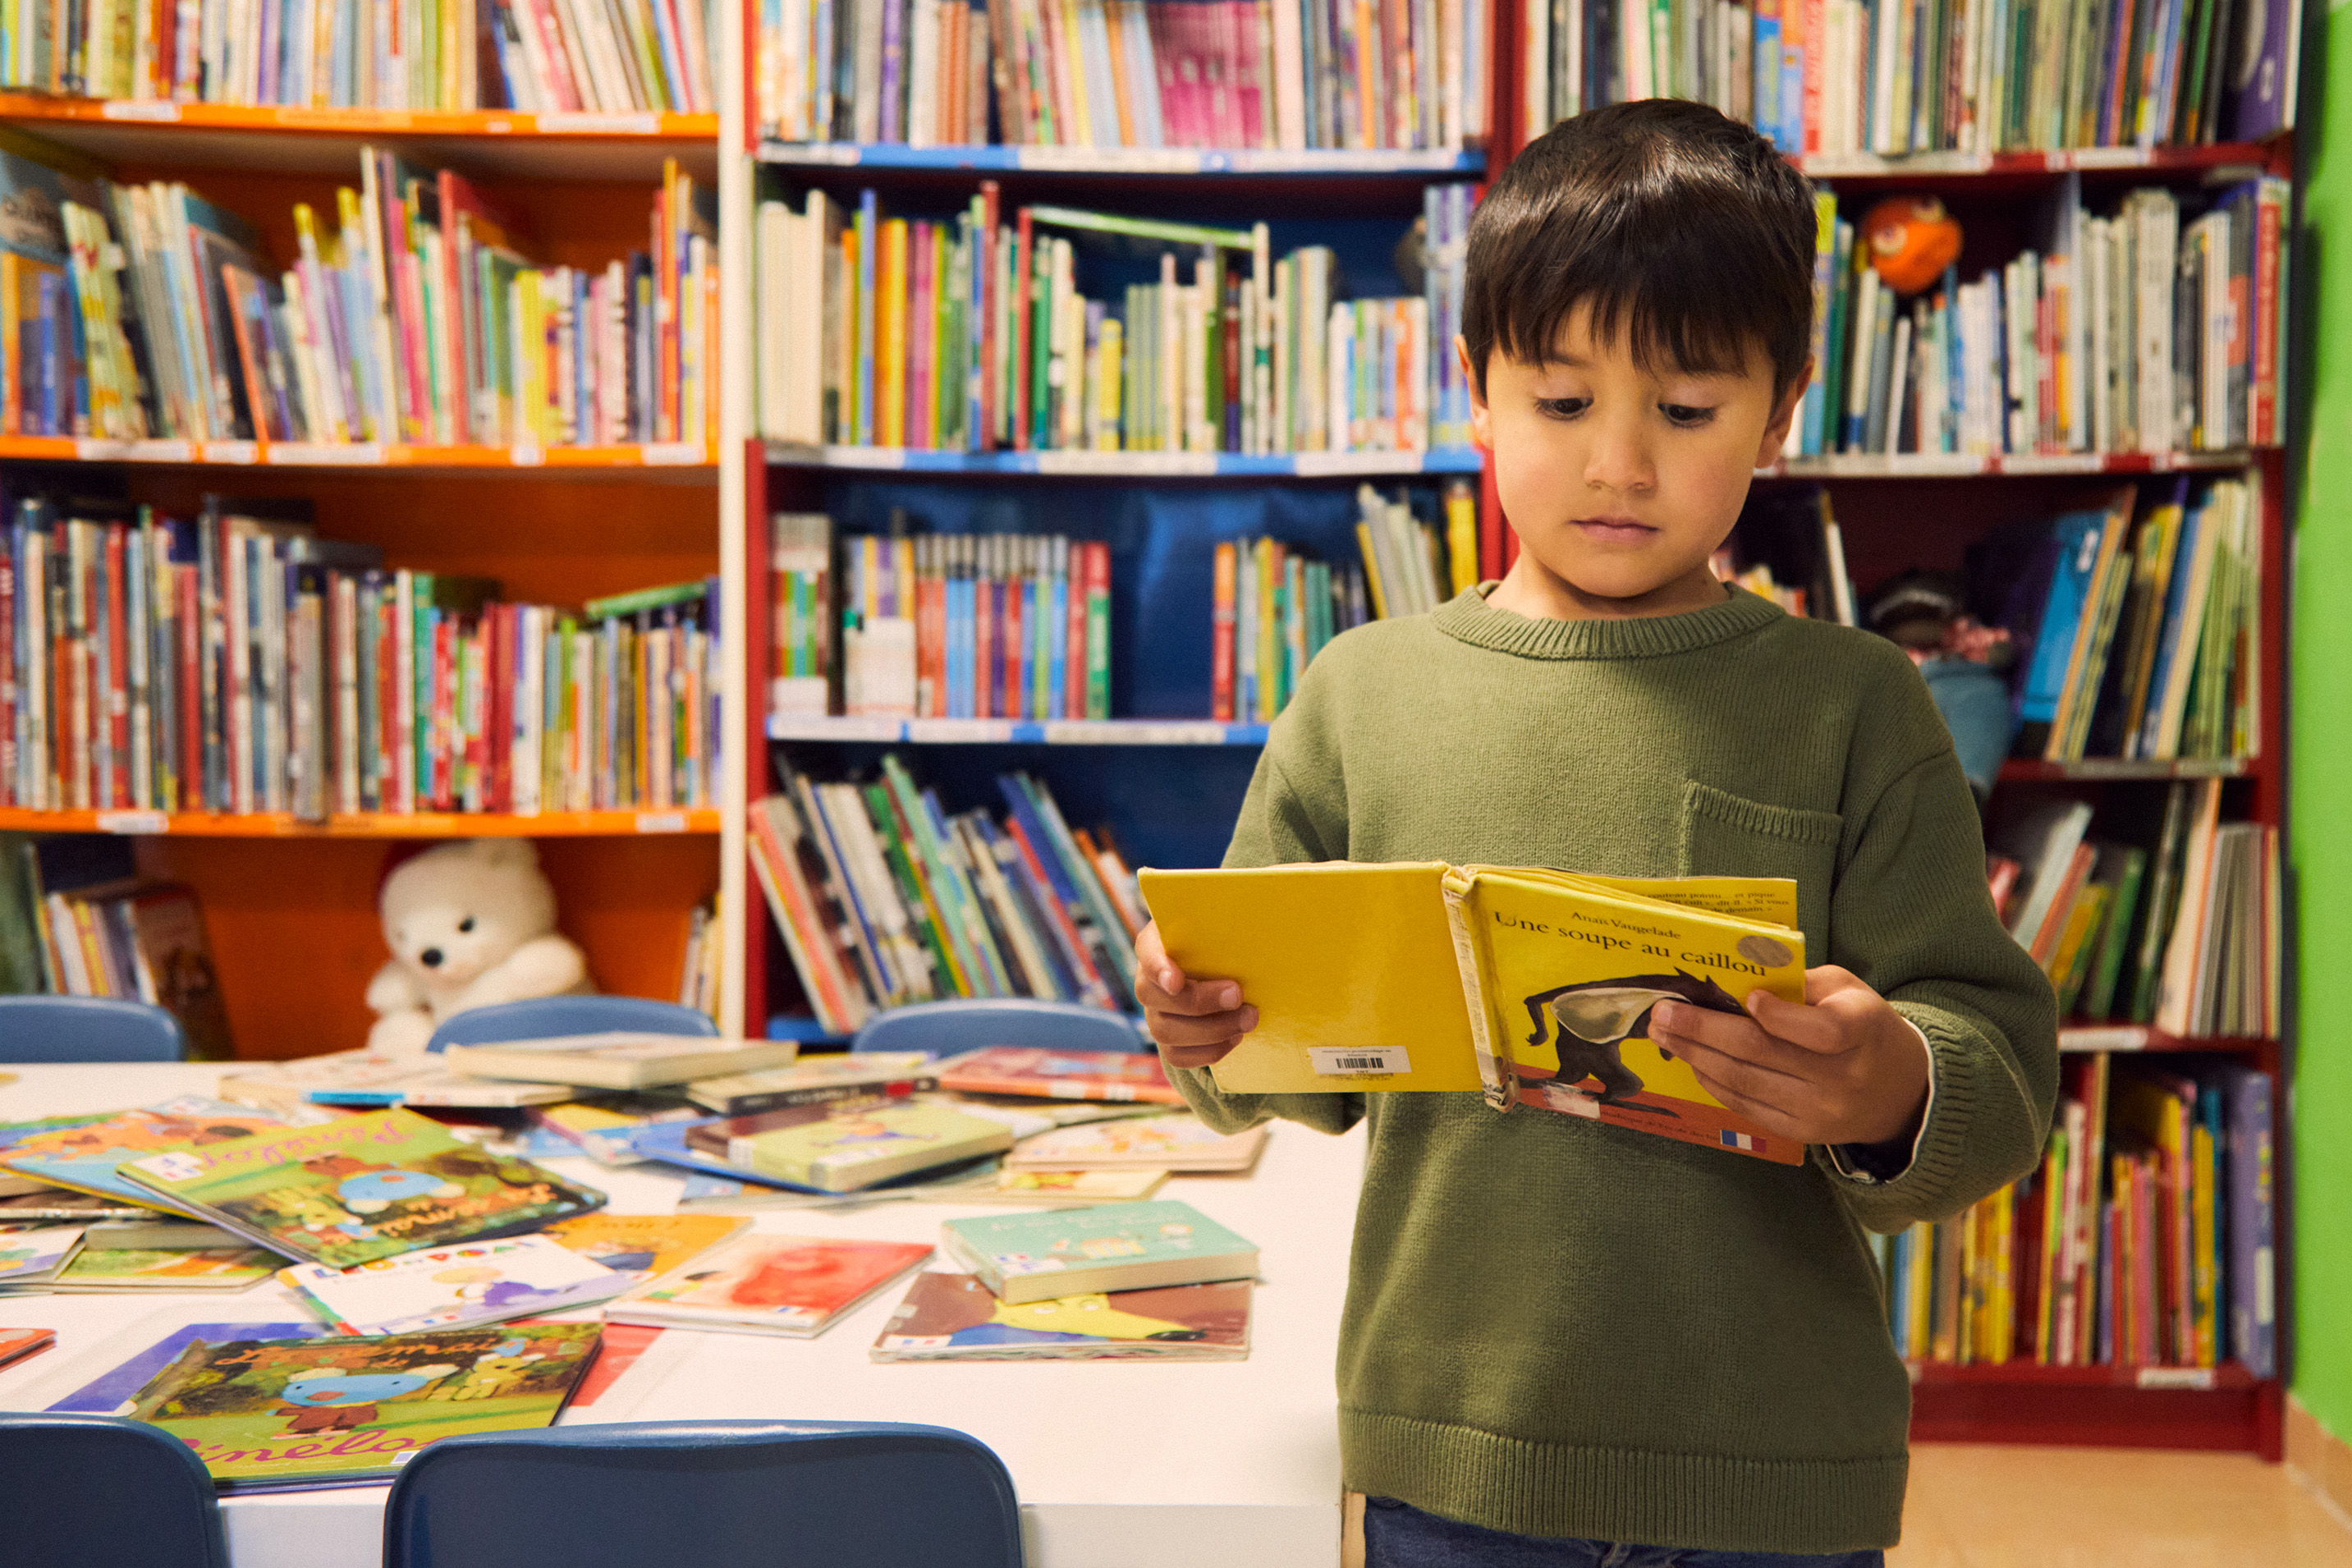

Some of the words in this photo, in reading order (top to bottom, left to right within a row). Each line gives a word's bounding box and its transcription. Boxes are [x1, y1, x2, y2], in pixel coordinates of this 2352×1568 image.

[1494, 910, 1549, 934] Une
[1557, 927, 1633, 950] soupe
[1641, 943, 1671, 958] au
[1680, 949, 1767, 977] caillou
[1571, 910, 1610, 927] Anaïs
[1611, 918, 1682, 940] Vaugelade
